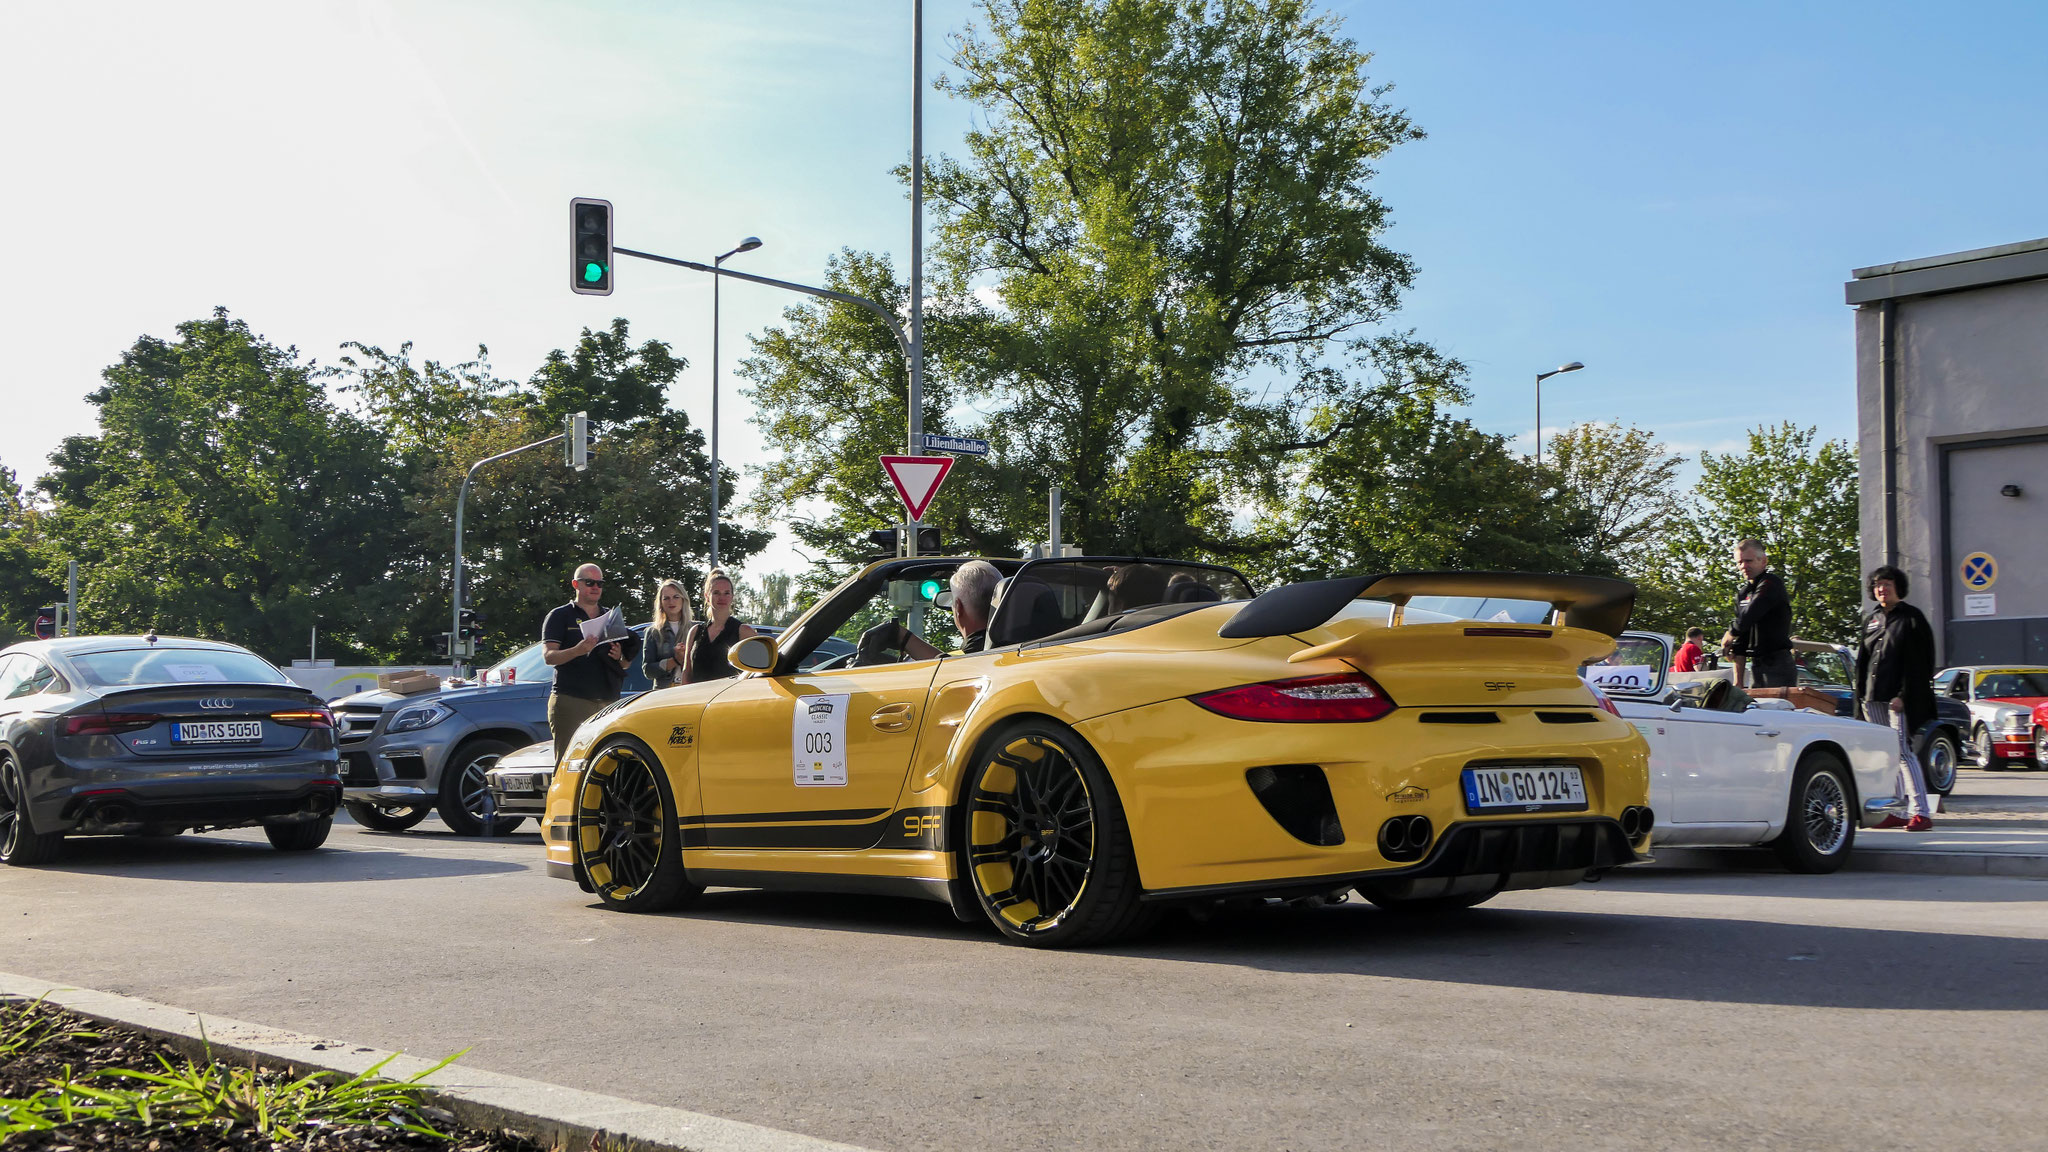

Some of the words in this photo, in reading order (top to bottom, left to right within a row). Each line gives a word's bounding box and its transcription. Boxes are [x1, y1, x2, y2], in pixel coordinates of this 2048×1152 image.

[925, 436, 986, 452] Lilienthalallee
[182, 724, 199, 738] ND
[208, 723, 225, 738] RS
[228, 723, 260, 737] 5050
[805, 732, 832, 754] 003
[1477, 773, 1502, 803] IN
[1512, 772, 1537, 801] GO
[1538, 771, 1571, 801] 124
[1469, 792, 1475, 801] D
